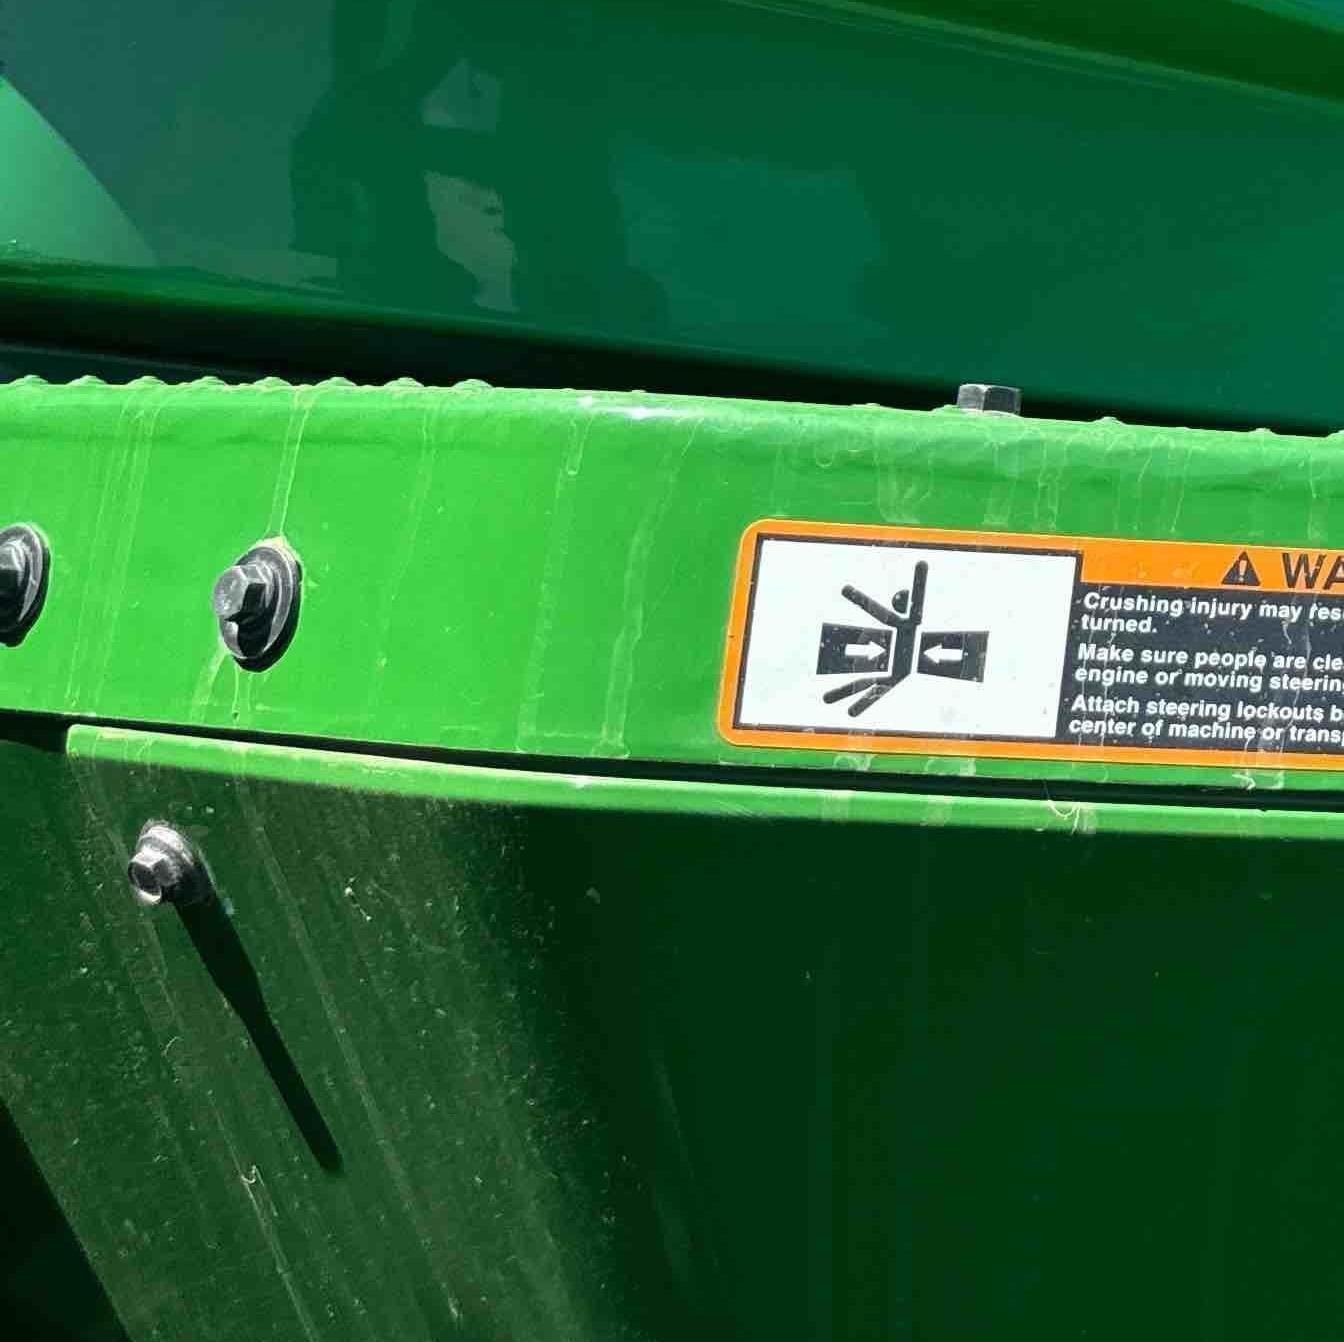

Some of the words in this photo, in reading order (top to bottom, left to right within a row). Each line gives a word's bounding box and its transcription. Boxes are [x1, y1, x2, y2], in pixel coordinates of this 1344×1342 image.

[1084, 592, 1183, 617] Crushing
[1191, 598, 1251, 619] injury
[1259, 603, 1302, 622] may
[1081, 614, 1157, 633] turned.
[1078, 644, 1134, 662] Make
[1141, 649, 1188, 664] sure
[1195, 649, 1266, 668] people
[1273, 655, 1306, 669] are
[1076, 666, 1148, 686] engine
[1156, 670, 1179, 685] or
[1184, 670, 1262, 692] moving
[1072, 695, 1139, 714] Attach
[1146, 698, 1230, 720] steering
[1237, 700, 1324, 720] lockouts
[1069, 717, 1136, 735] center
[1142, 719, 1162, 736] of
[1168, 721, 1256, 739] machine
[1262, 724, 1282, 740] or
